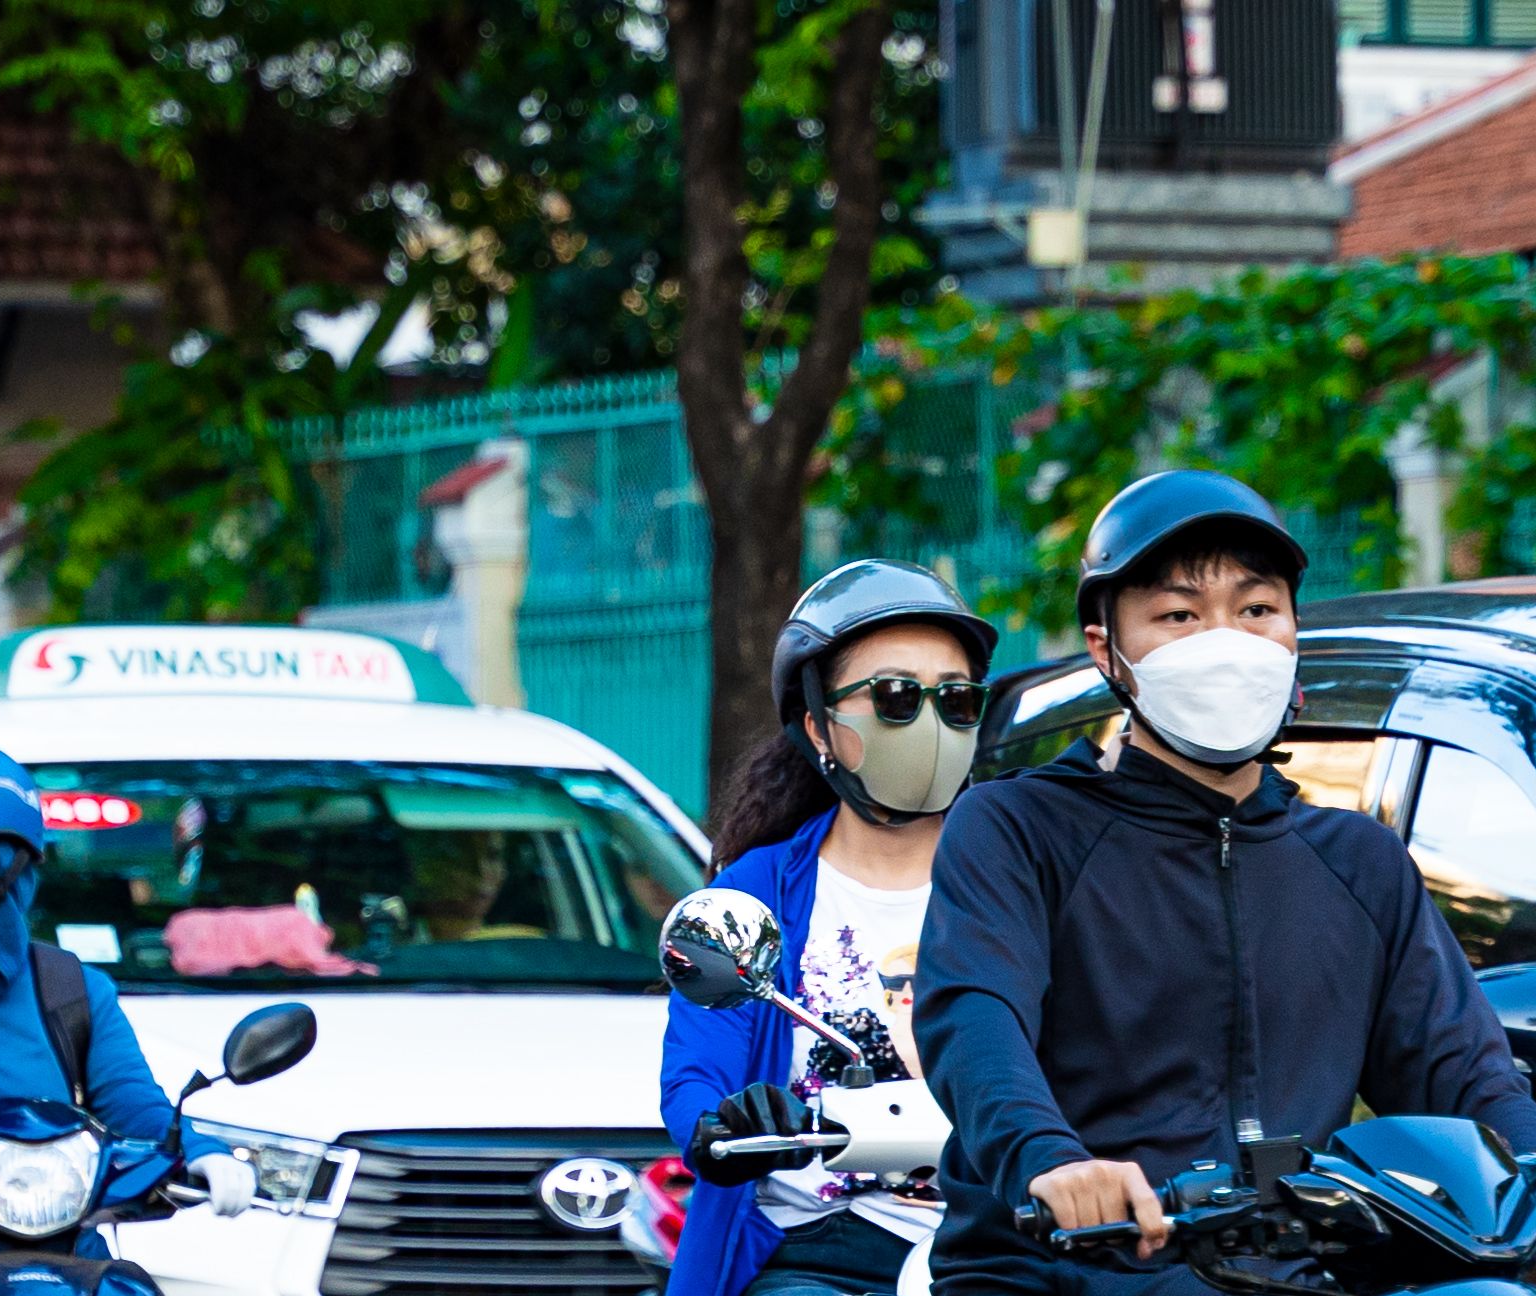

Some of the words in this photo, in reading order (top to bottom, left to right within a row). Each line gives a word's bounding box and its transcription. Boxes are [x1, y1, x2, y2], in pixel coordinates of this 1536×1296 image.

[107, 647, 300, 680] VINASUN
[312, 651, 390, 683] TAXI
[8, 1271, 64, 1284] HONDA
